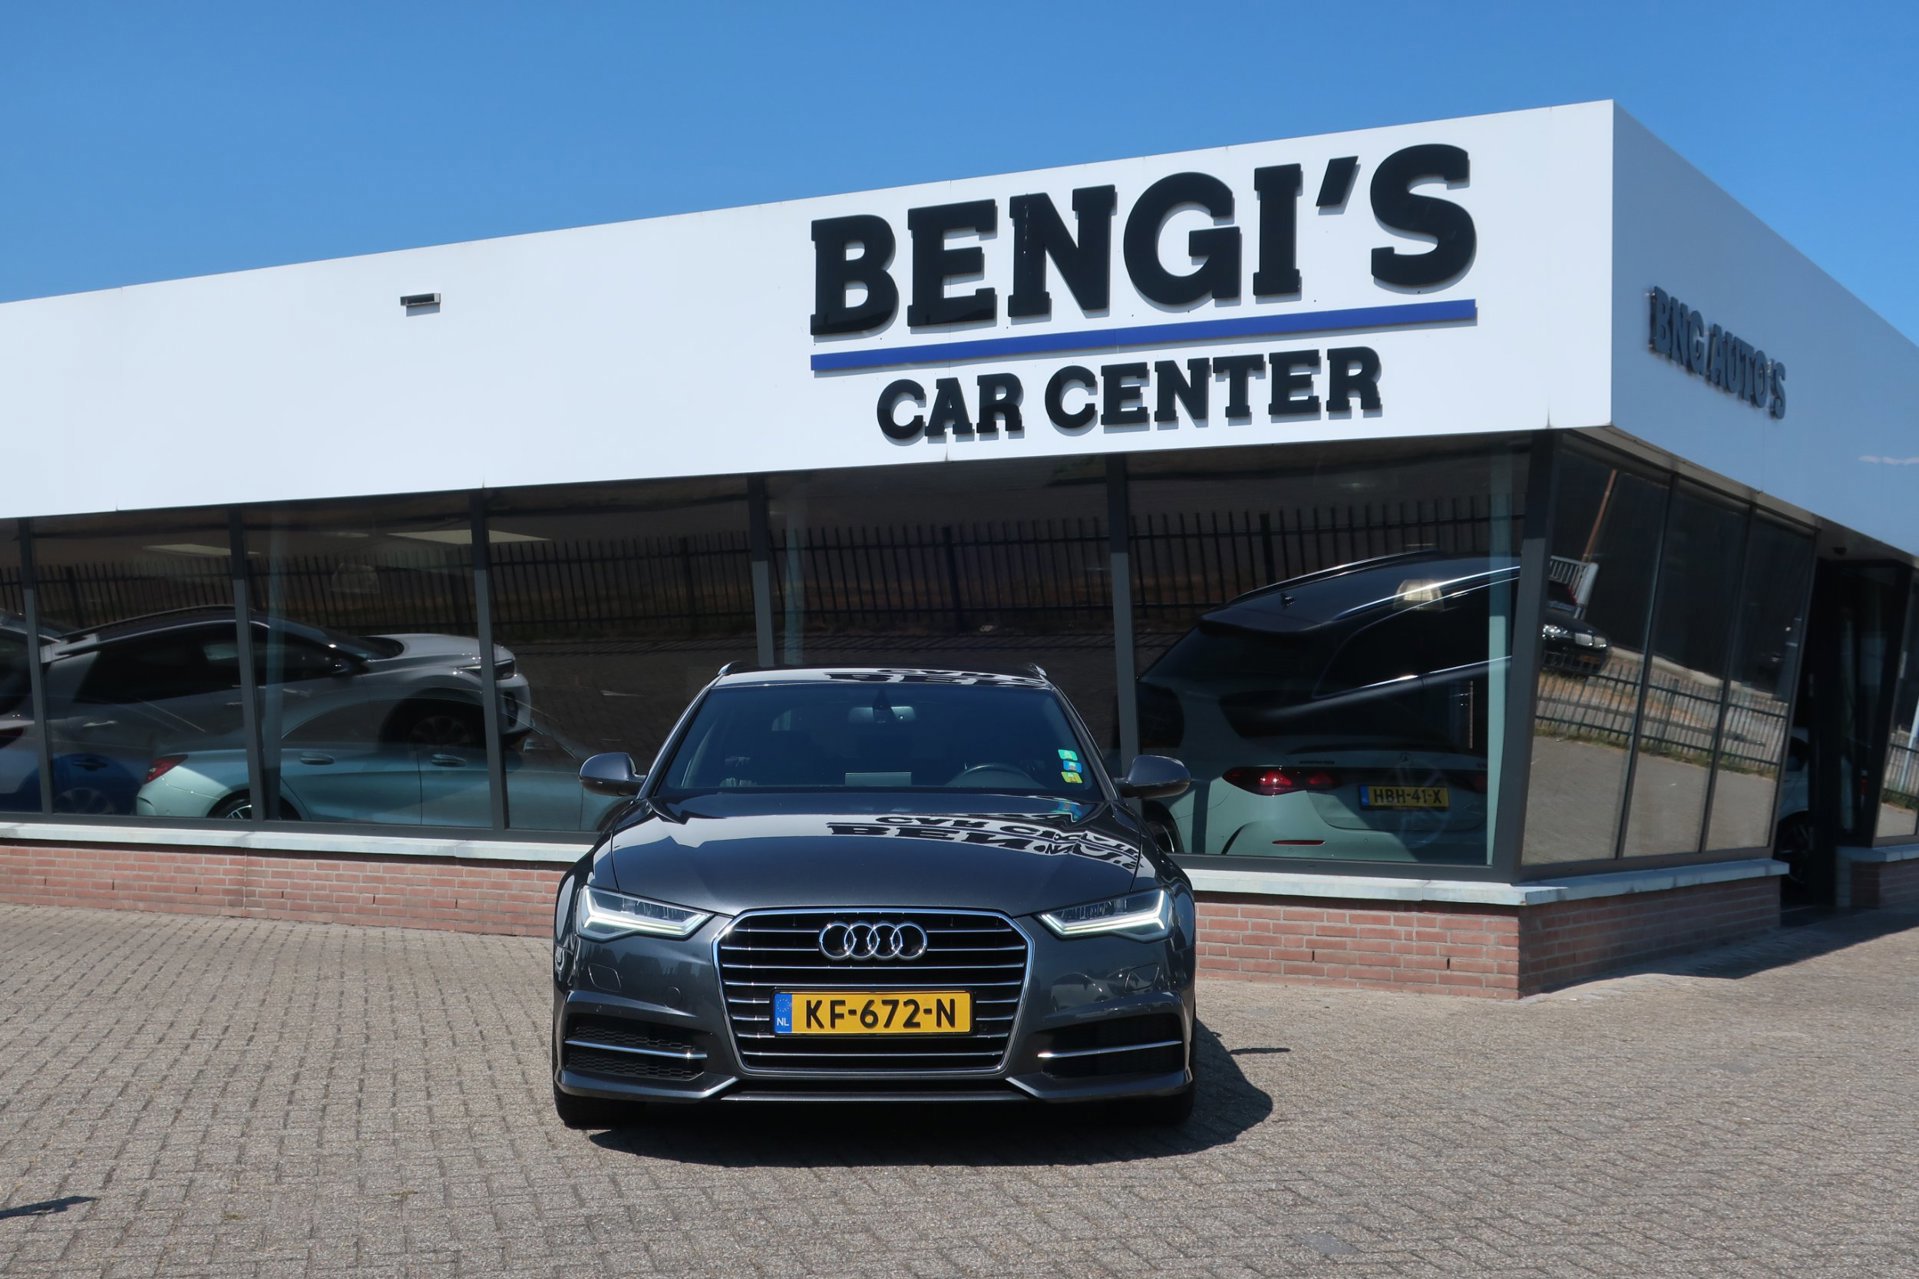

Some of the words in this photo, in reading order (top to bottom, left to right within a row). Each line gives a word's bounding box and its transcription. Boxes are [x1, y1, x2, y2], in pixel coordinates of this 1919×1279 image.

[810, 143, 1477, 335] BENGI'S
[877, 373, 1023, 440] CAR
[1044, 346, 1382, 430] CENTER
[1648, 286, 1704, 376] BNG
[1705, 323, 1786, 420] AUTO'S
[776, 1018, 790, 1027] NL
[805, 998, 956, 1029] KF-672-N
